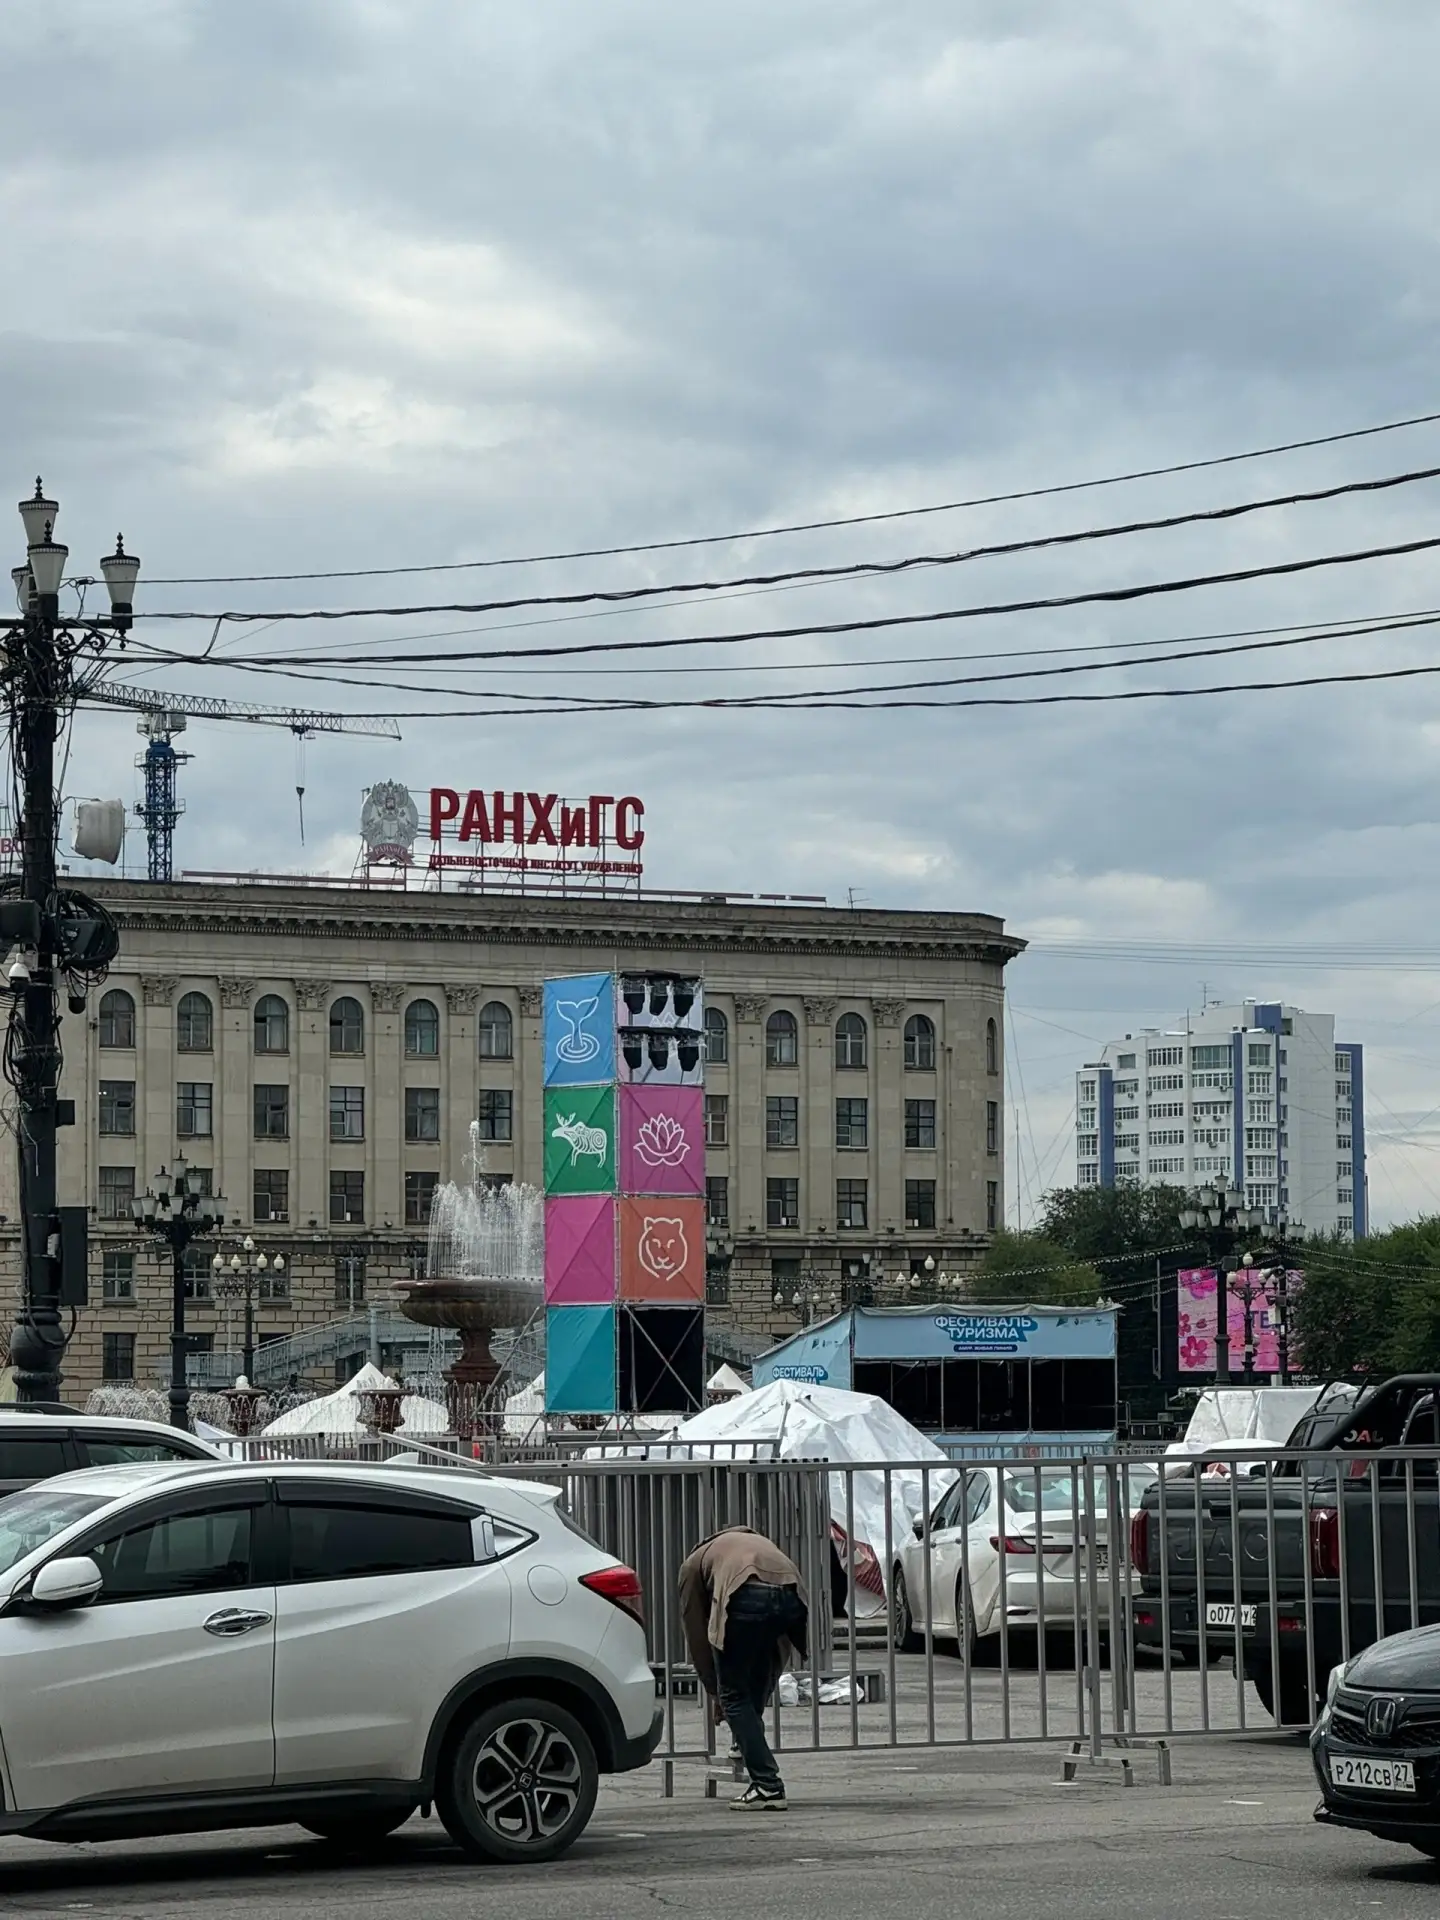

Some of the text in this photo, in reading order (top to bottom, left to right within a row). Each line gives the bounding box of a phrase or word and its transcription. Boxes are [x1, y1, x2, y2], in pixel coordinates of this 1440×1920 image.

[430, 787, 645, 850] РАНХиГС
[935, 1316, 1032, 1328] ФЕСТИВАЛЬ
[949, 1327, 1019, 1339] ТУРИЗМА
[772, 1366, 825, 1378] ФЕСТИВАЛЬ
